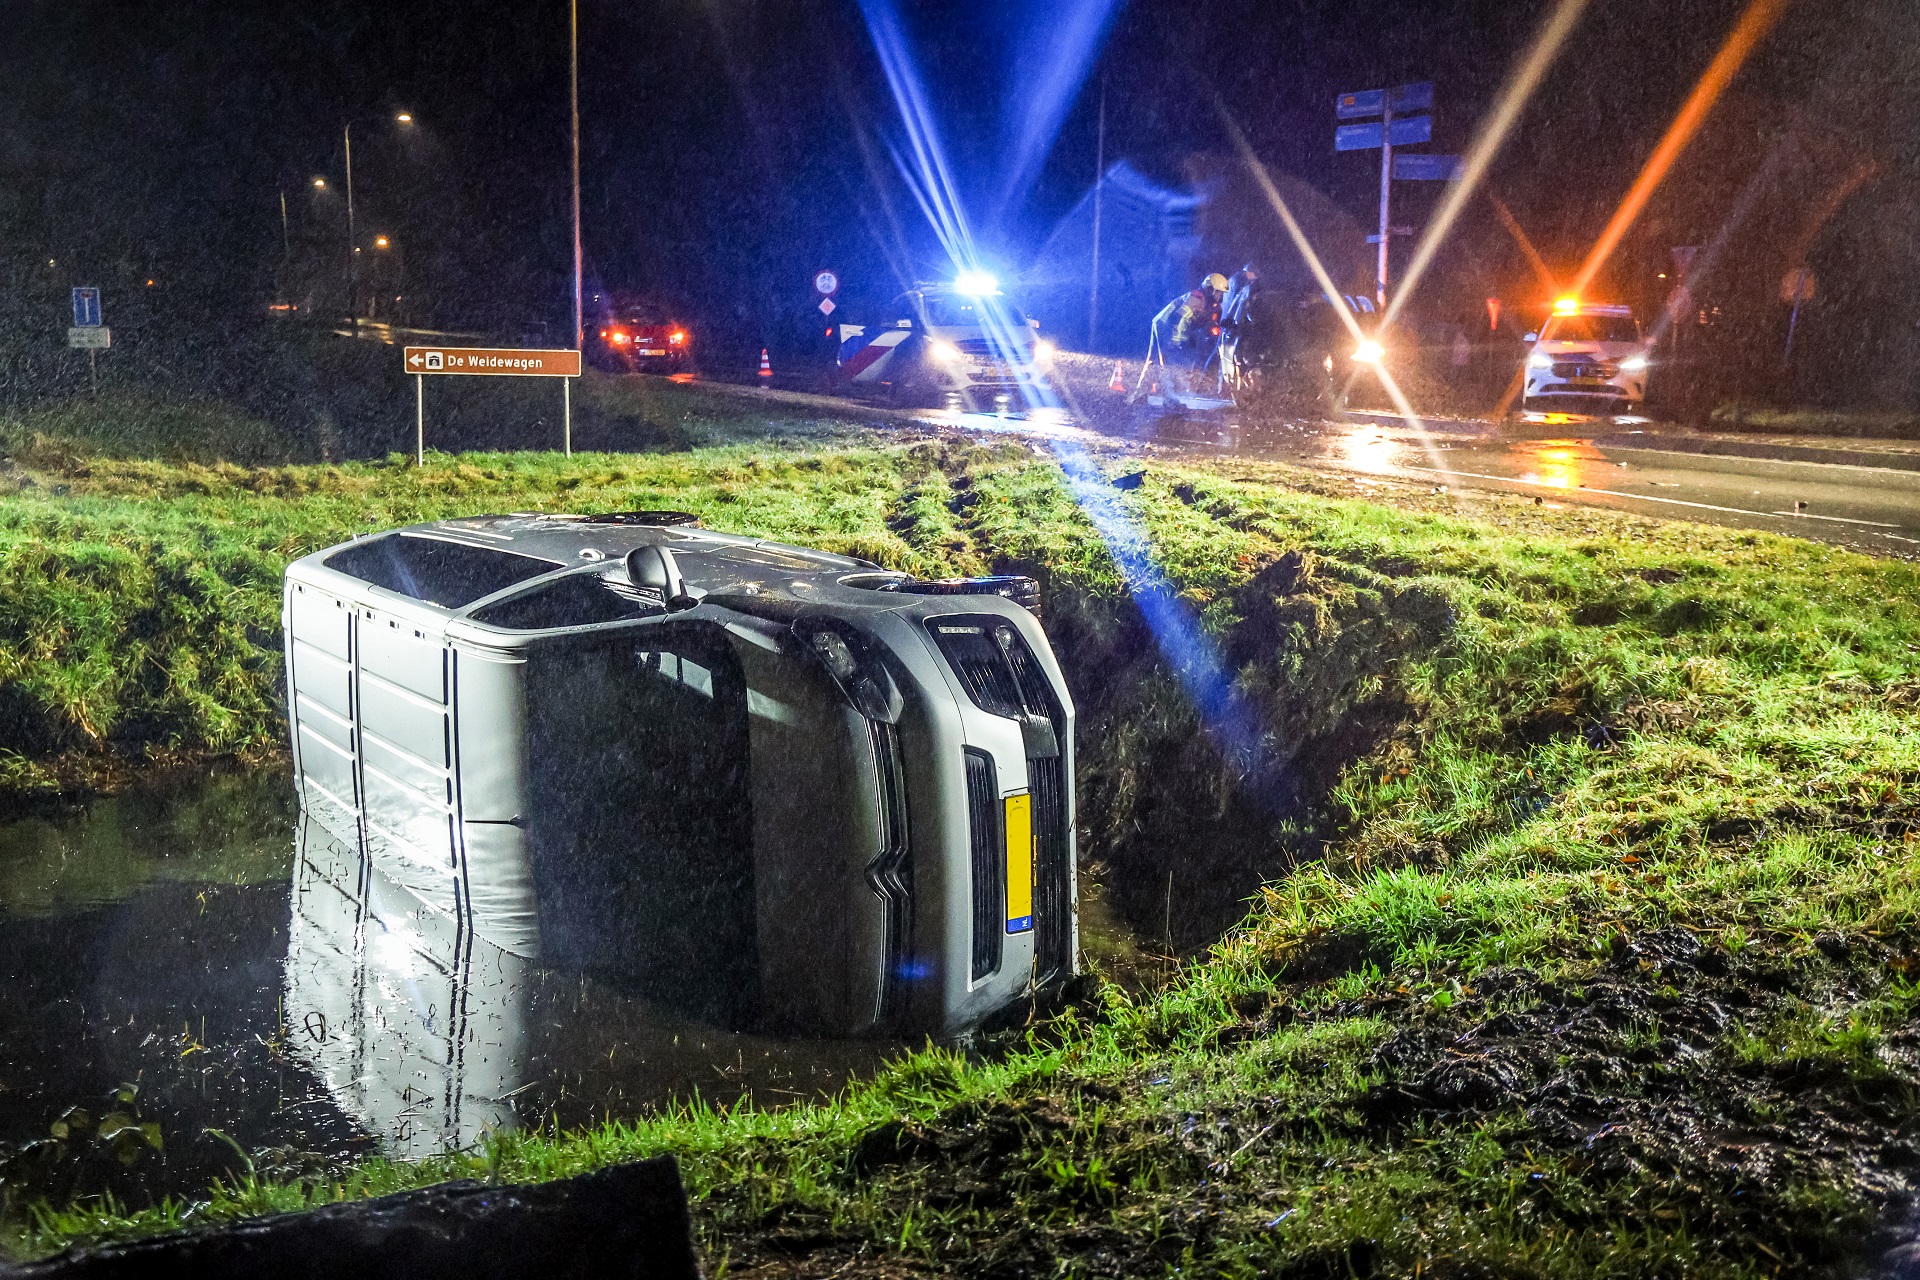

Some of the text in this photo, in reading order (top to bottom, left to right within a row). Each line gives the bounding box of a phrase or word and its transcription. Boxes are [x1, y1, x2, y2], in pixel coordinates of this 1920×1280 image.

[447, 355, 543, 371] De Weidewagen
[1021, 917, 1028, 928] NL
